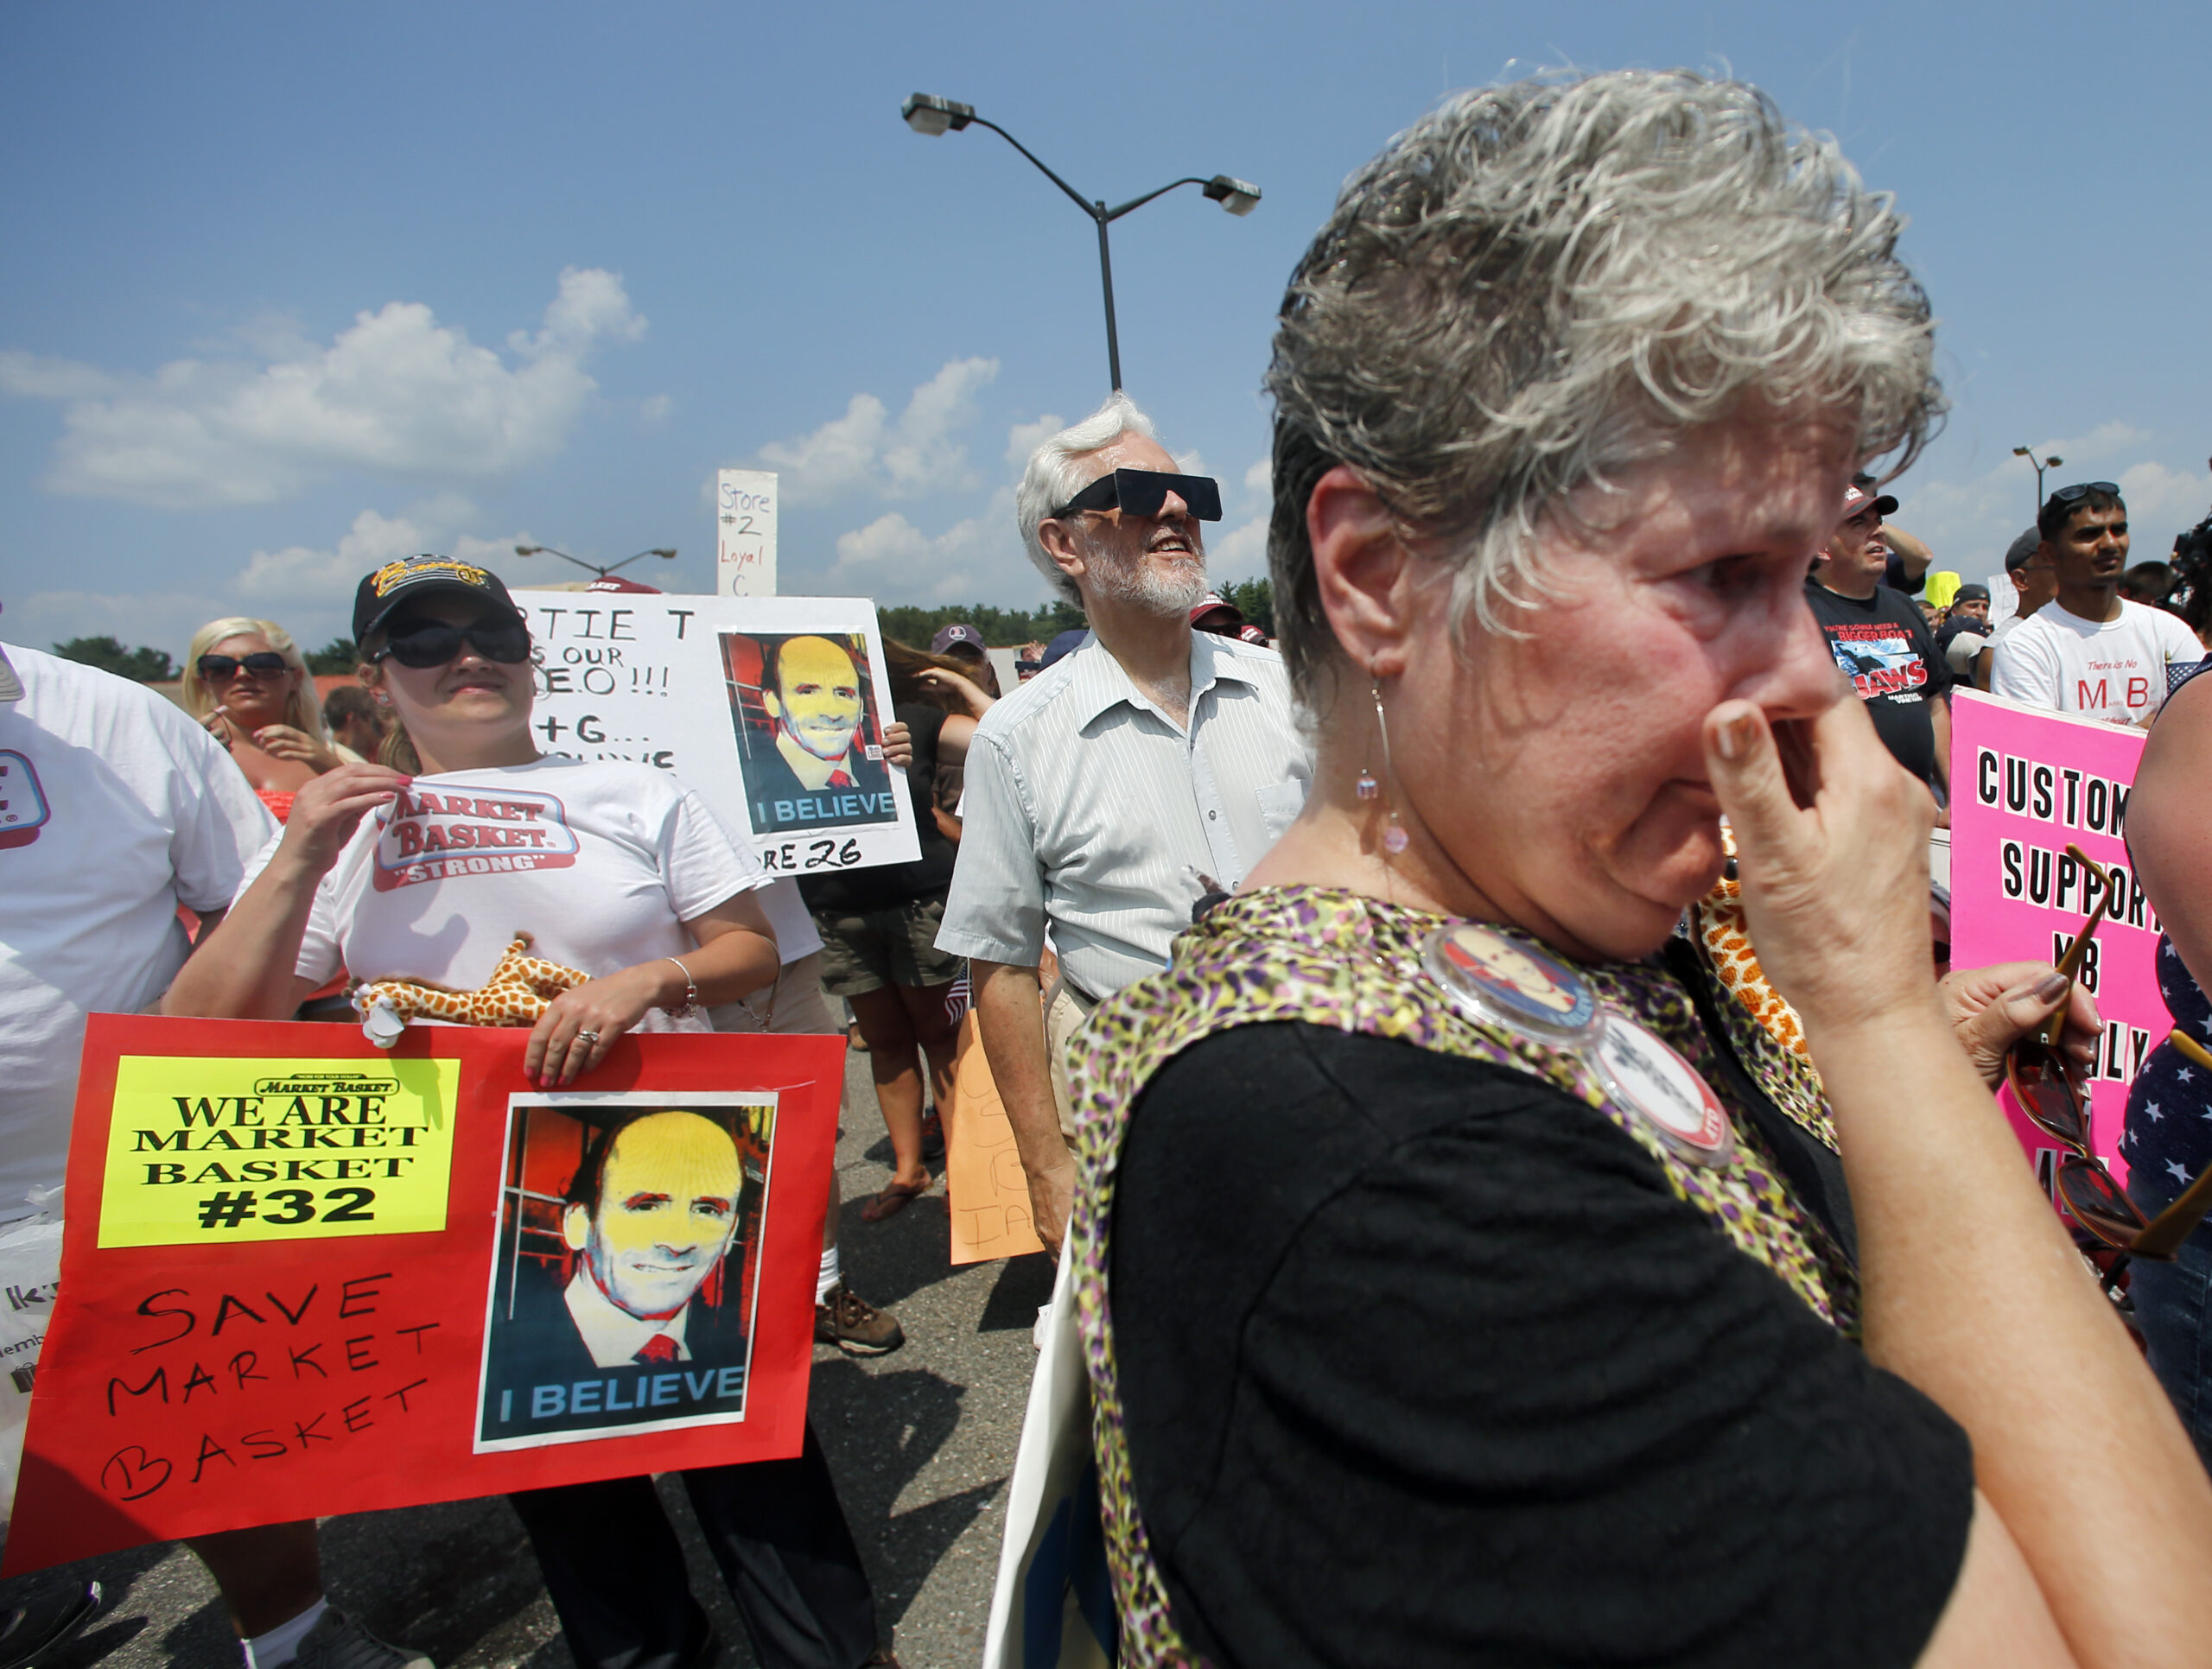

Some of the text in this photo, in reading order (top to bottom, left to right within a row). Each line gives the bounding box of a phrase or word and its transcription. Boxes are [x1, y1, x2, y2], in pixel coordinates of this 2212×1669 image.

[720, 483, 770, 513] Store
[721, 540, 764, 571] Loyal
[1837, 631, 1879, 642] BIGGER
[563, 647, 624, 668] OUR
[2125, 659, 2137, 669] No
[1854, 660, 1928, 699] JAWS
[391, 790, 546, 822] MARKET
[757, 792, 897, 823] I BELIEVE
[392, 822, 546, 858] BASKET
[755, 838, 861, 871] RE 26
[260, 1082, 392, 1093] MARKET BASKET
[173, 1095, 386, 1127] WE ARE
[130, 1126, 428, 1152] MARKET
[141, 1158, 414, 1185] BASKET
[198, 1187, 375, 1228] #32
[130, 1272, 392, 1355] SAVE
[107, 1323, 439, 1415] MARKET
[499, 1367, 745, 1422] I BELIEVE
[101, 1379, 428, 1501] BASKET
